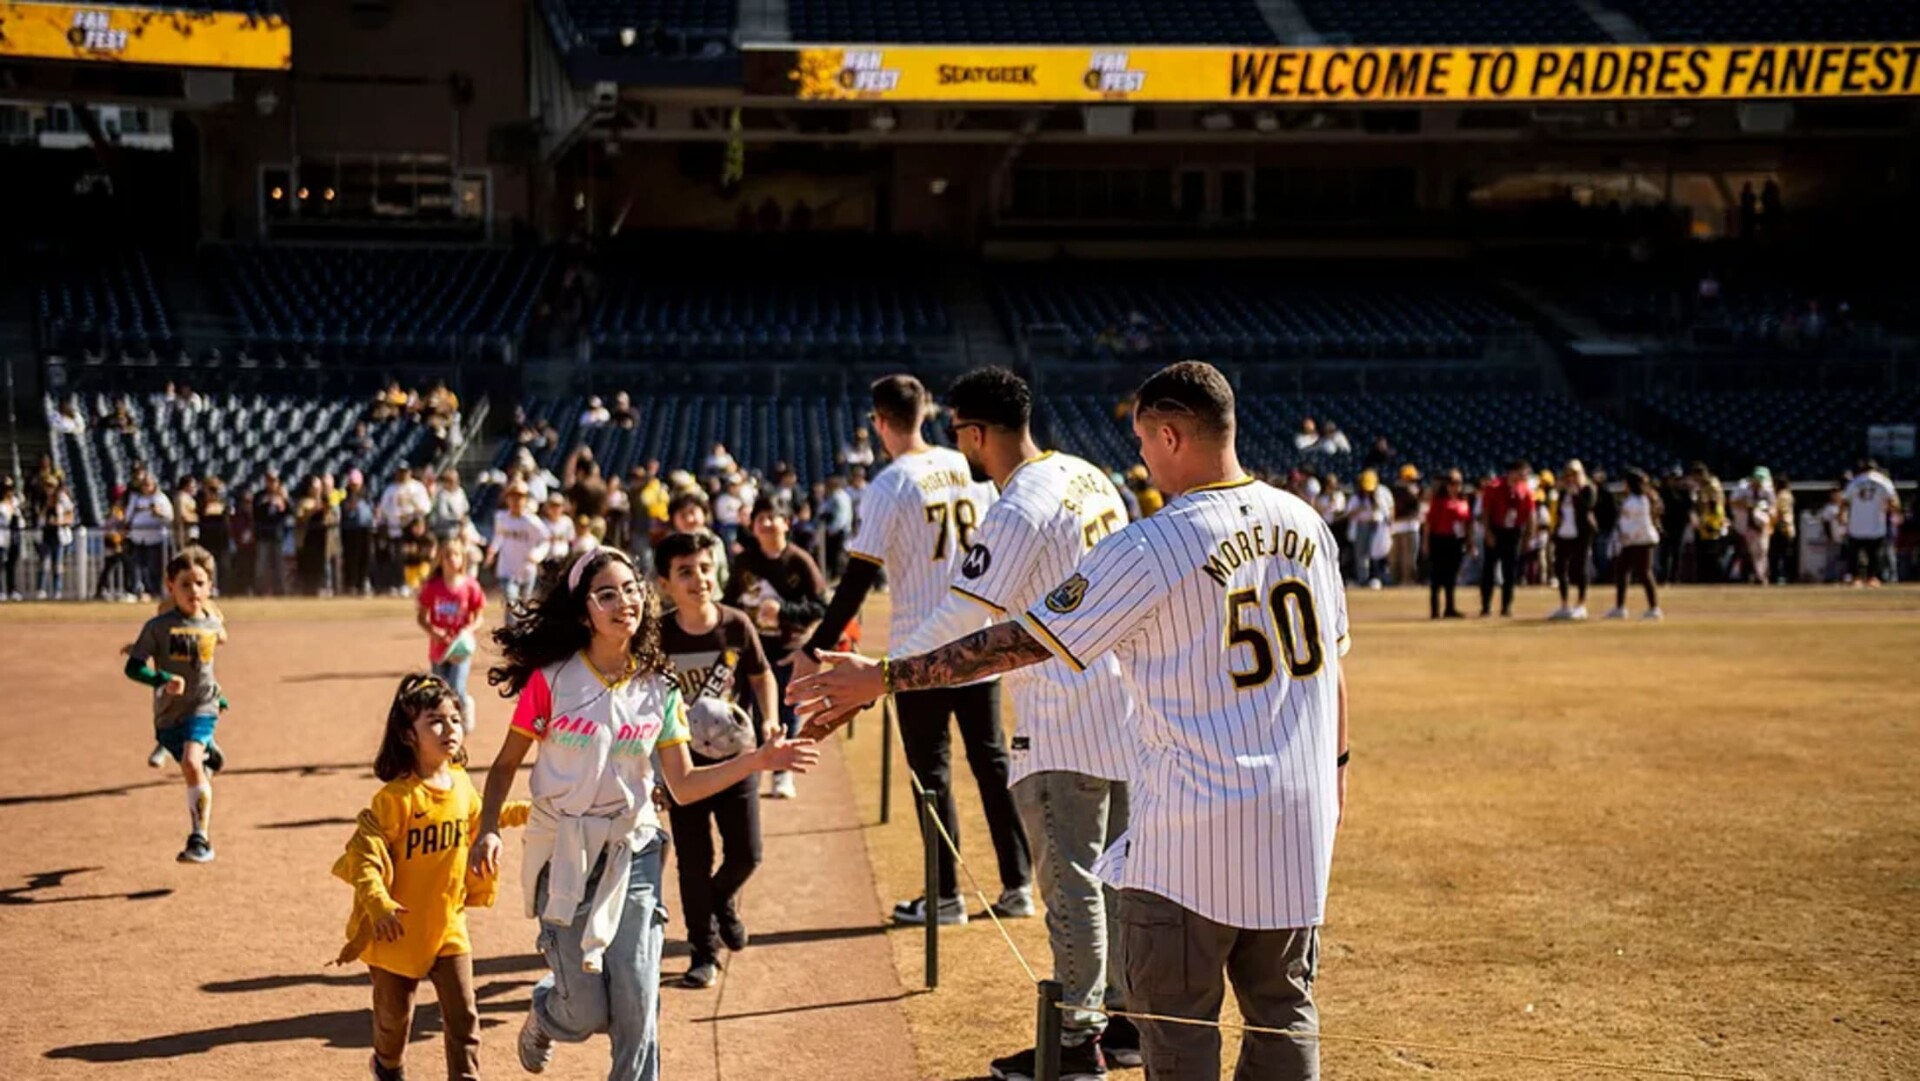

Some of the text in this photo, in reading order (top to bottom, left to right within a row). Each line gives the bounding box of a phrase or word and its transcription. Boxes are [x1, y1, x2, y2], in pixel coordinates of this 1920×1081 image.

[938, 65, 1038, 85] SEATGEEK
[1230, 48, 1920, 96] WELCOME TO PADRES FANFEST
[925, 499, 977, 562] 78
[1202, 524, 1317, 588] MOREJON
[1227, 577, 1325, 691] 50
